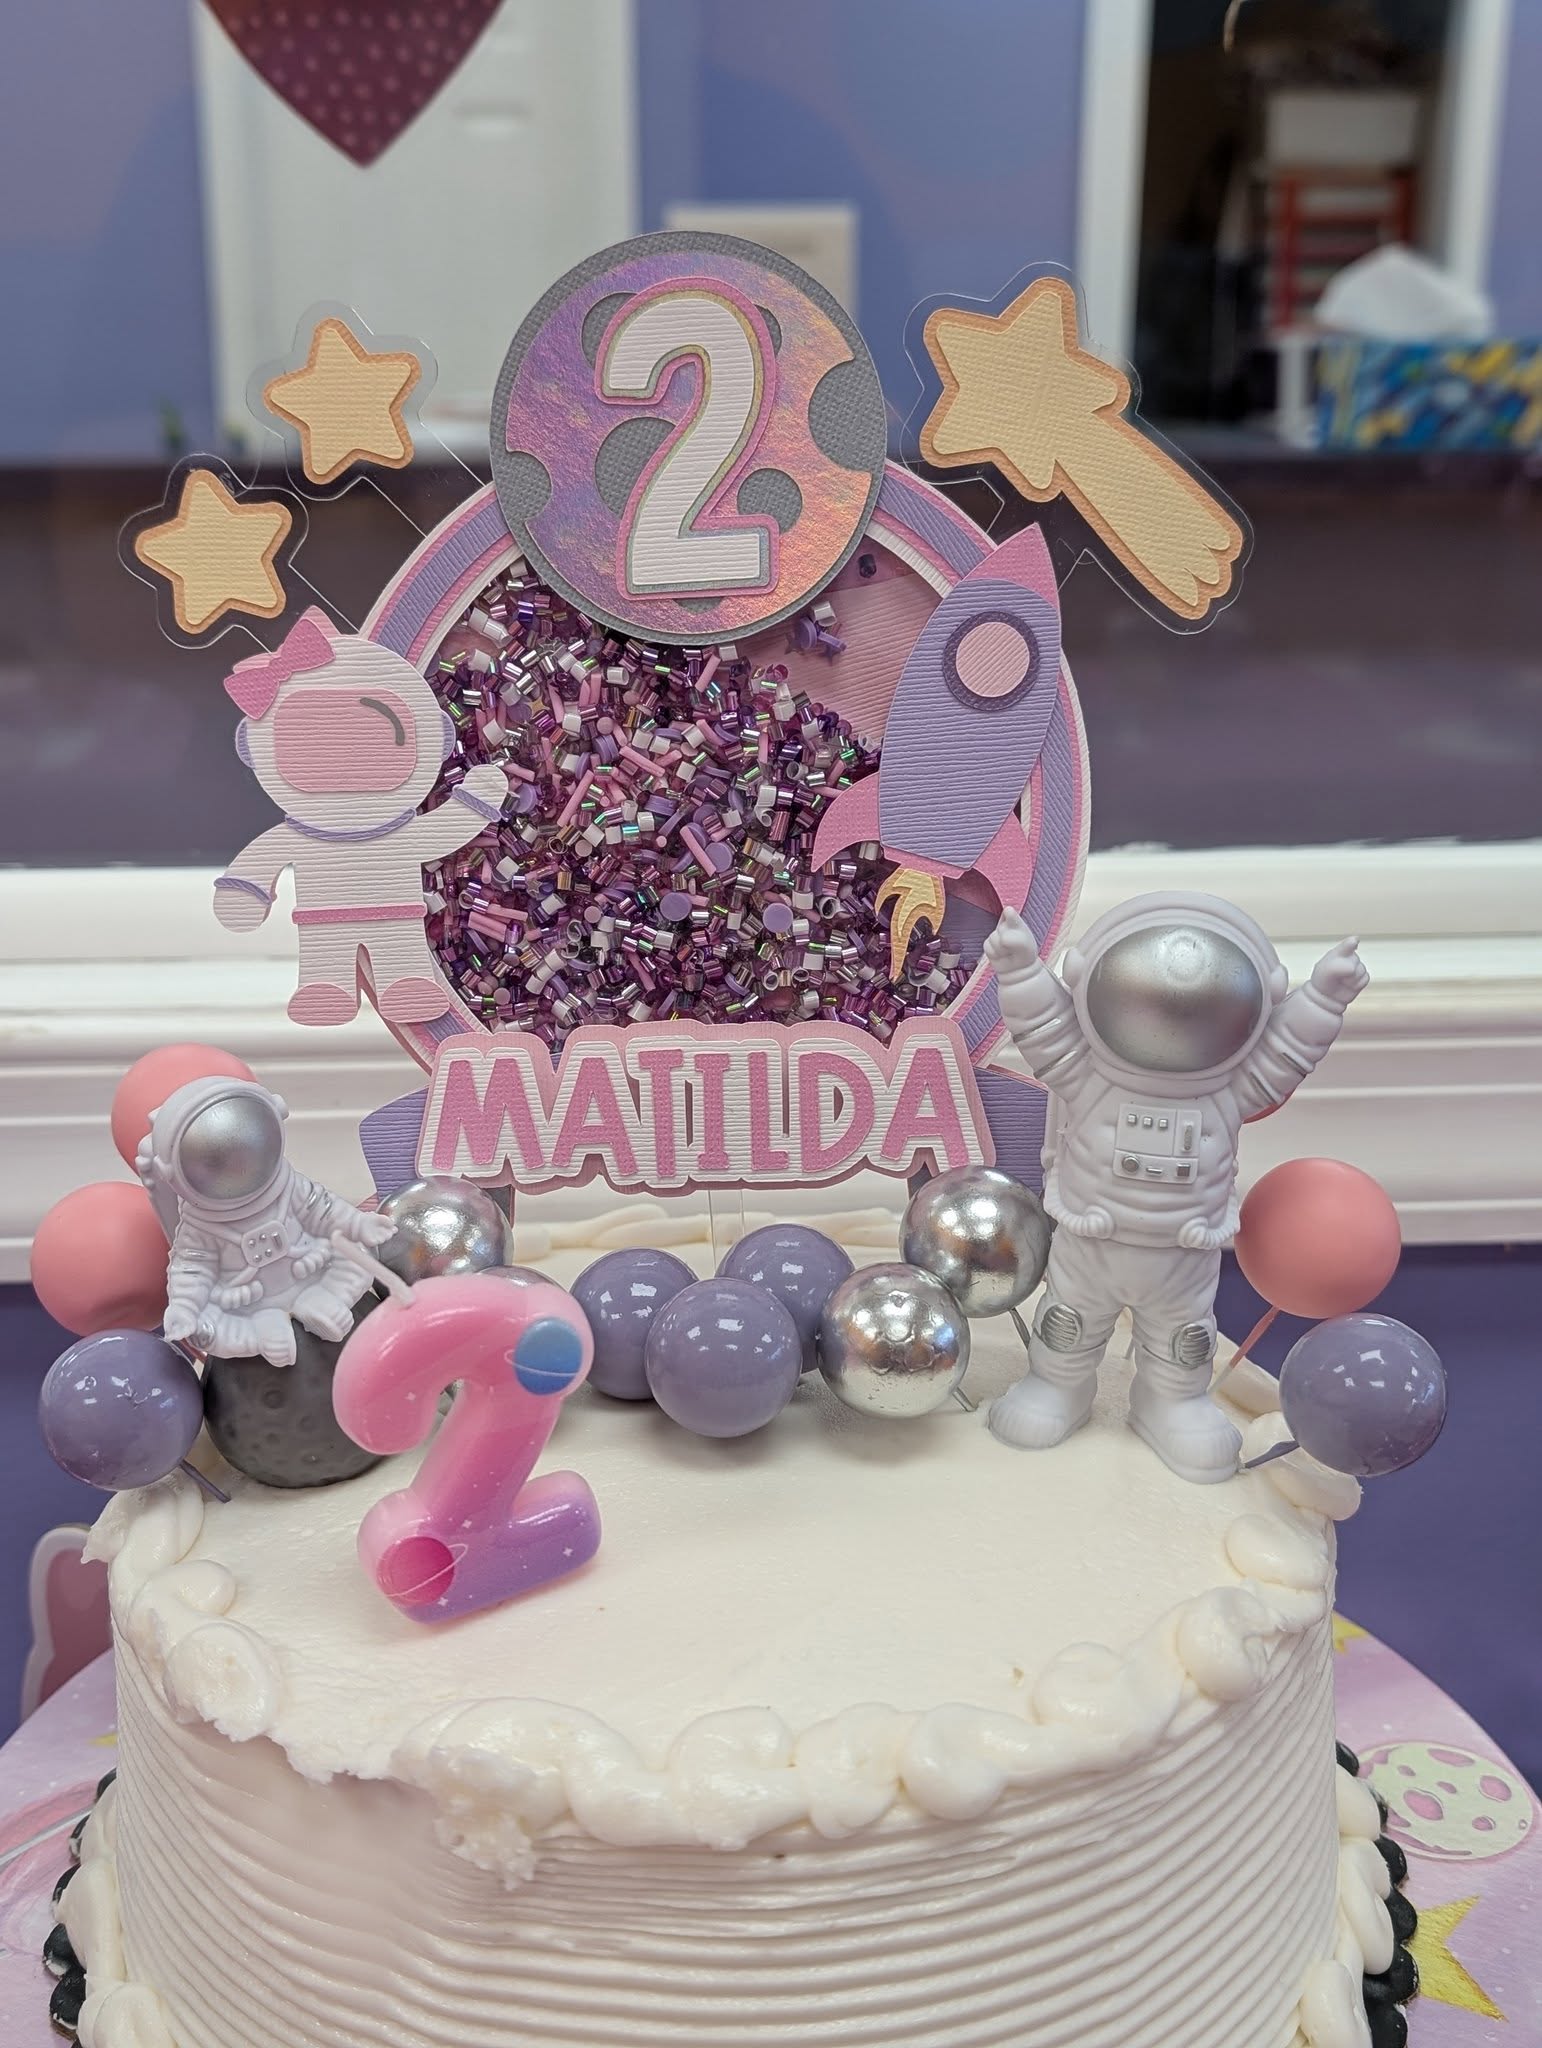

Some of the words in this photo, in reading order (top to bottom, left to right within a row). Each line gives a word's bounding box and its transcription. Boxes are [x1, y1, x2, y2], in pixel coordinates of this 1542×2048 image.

[605, 295, 765, 589] 2
[431, 1047, 968, 1178] MATILDA
[332, 1273, 602, 1625] 2
